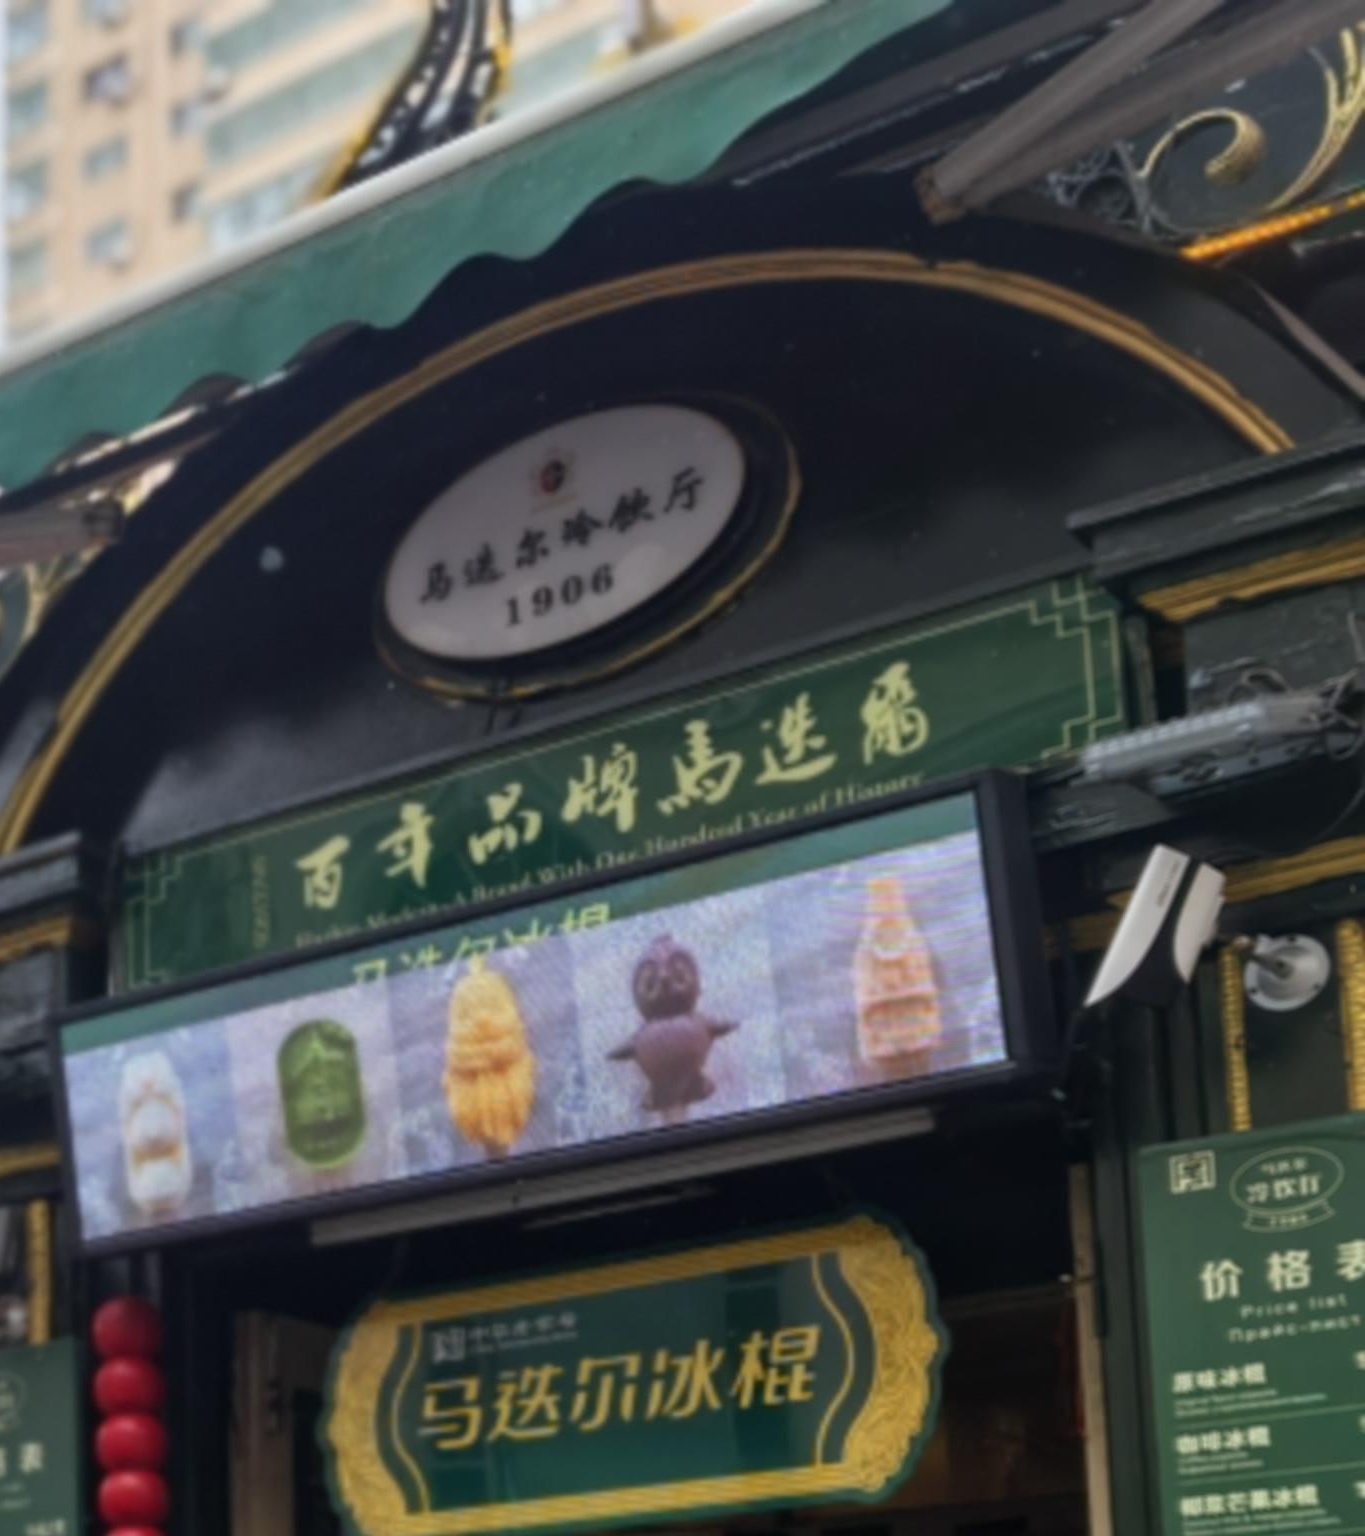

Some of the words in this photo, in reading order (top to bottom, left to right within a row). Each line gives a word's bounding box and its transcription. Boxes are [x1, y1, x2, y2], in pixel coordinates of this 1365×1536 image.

[418, 465, 705, 604] 马迭尔冷饮厅
[504, 562, 616, 627] 1906
[1240, 1300, 1300, 1320] Price
[418, 1325, 822, 1450] 马迭尔冰棍
